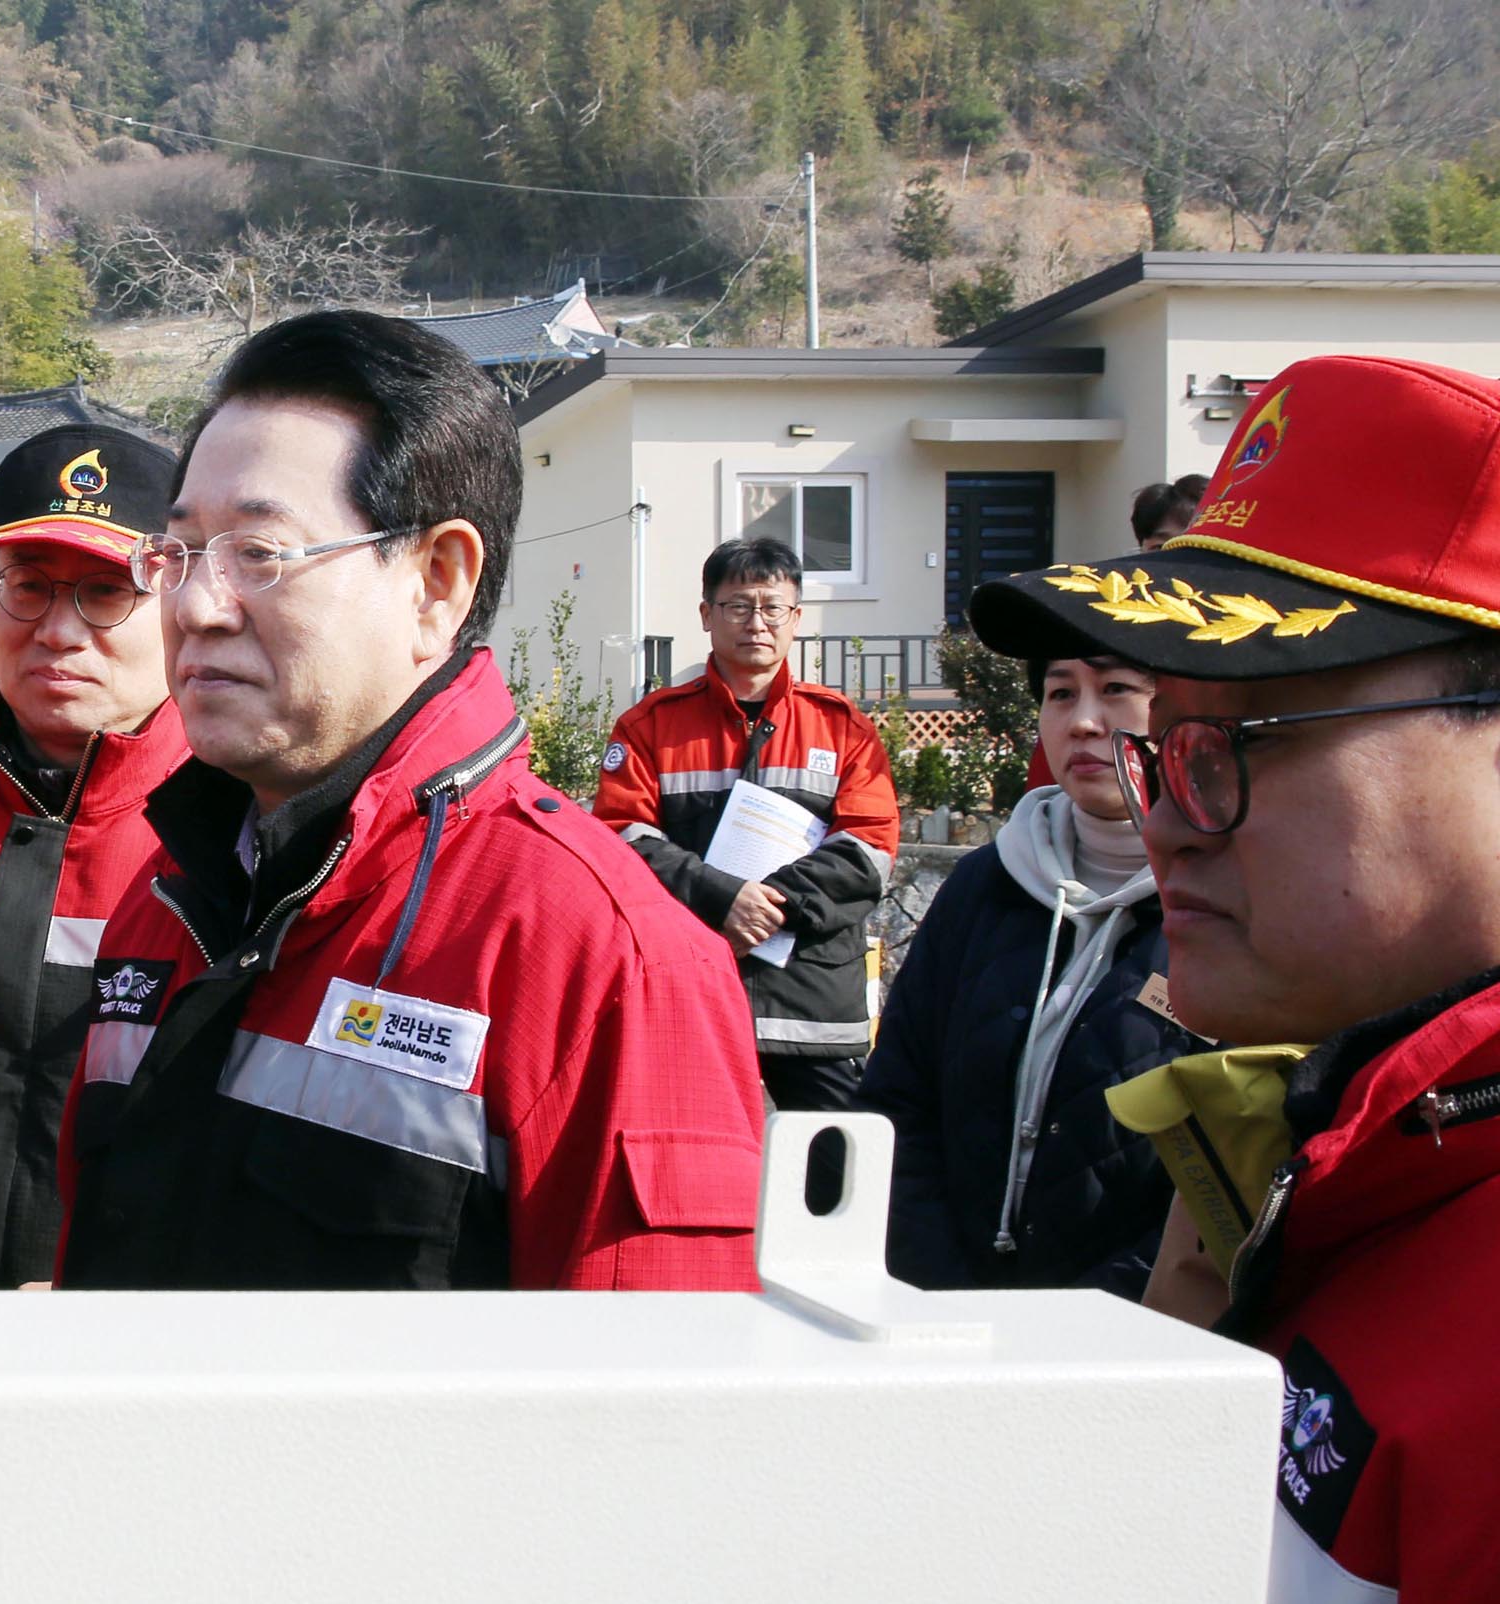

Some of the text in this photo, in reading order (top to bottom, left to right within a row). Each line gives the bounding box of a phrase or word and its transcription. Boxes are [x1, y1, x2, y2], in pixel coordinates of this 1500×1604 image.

[49, 499, 111, 517] 산불조심
[1190, 500, 1258, 528] 불조심
[116, 1001, 142, 1014] POLICE
[384, 1013, 453, 1047] 전라남도
[377, 1036, 447, 1064] JeollaNamdo
[1280, 1456, 1311, 1506] POLICE
